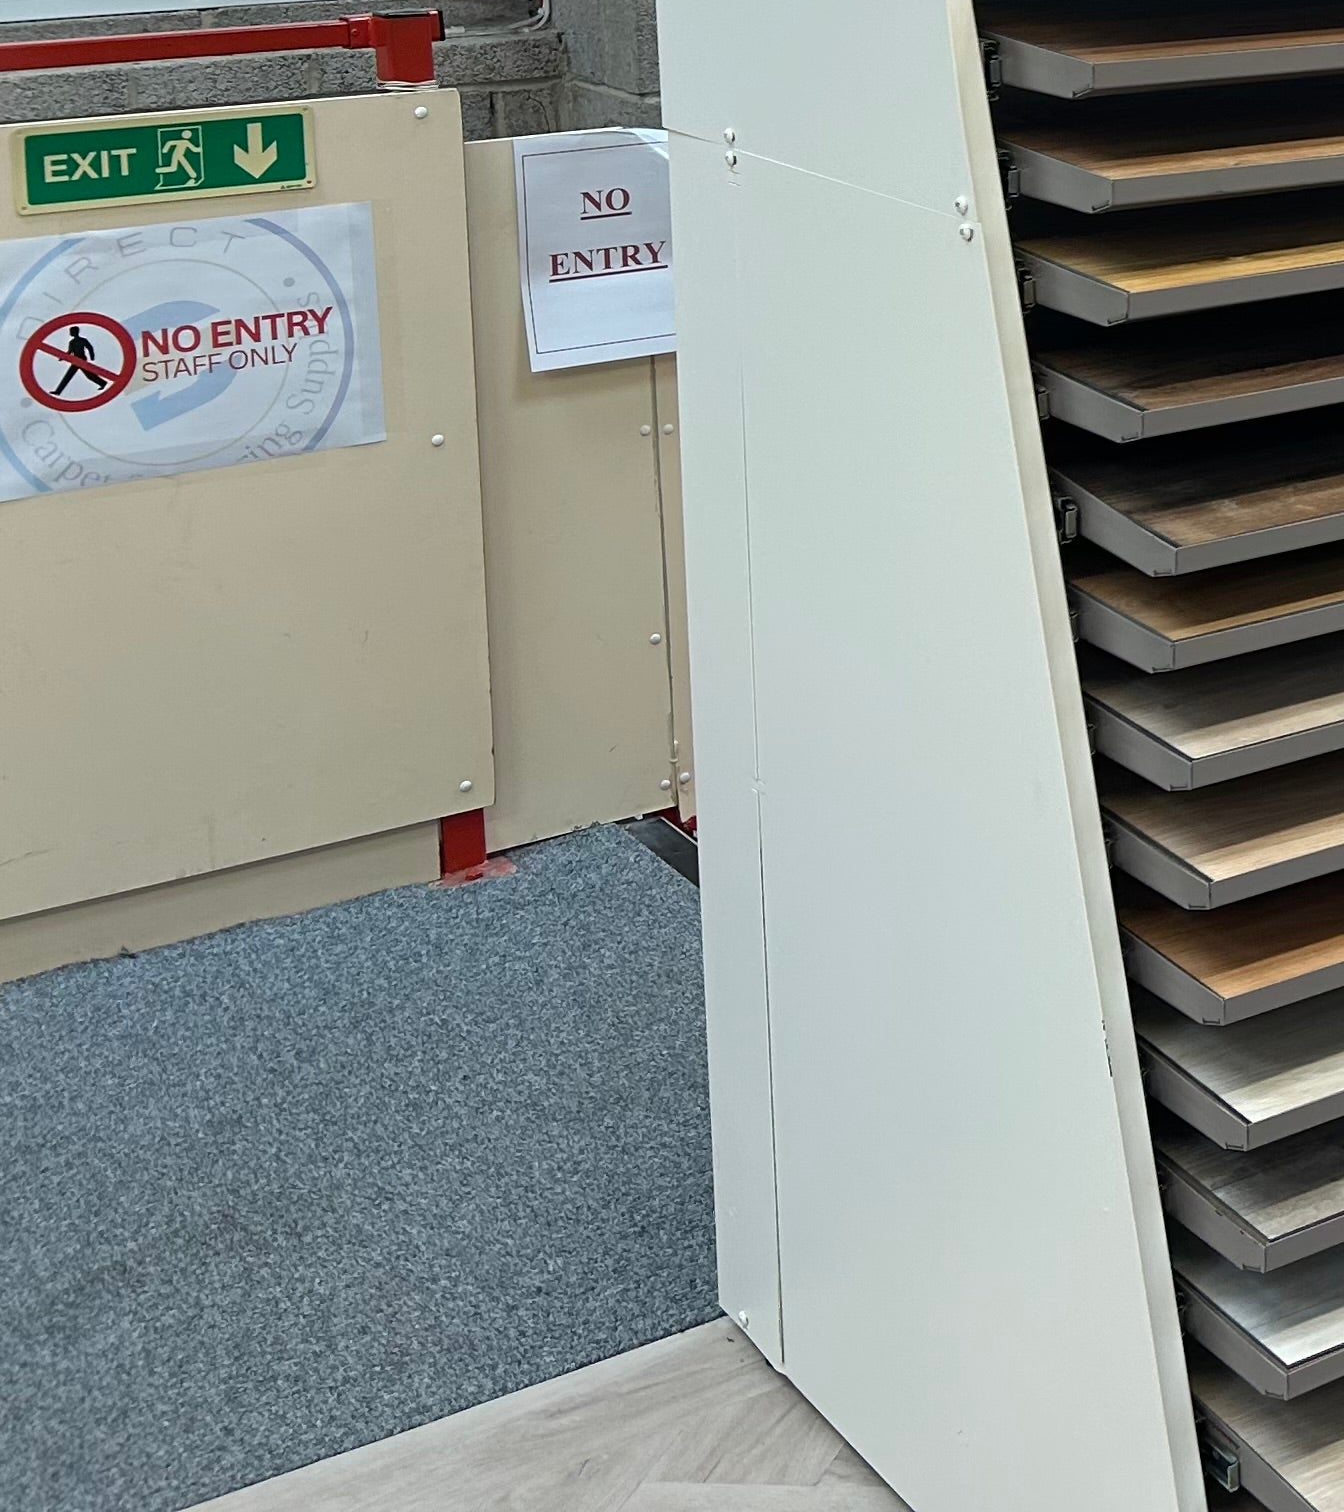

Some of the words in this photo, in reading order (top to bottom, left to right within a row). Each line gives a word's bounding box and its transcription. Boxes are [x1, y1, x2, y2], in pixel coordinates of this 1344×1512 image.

[44, 147, 137, 183] EXIT
[581, 187, 631, 214] NO
[549, 240, 667, 277] ENTRY
[17, 226, 246, 341] DIRECT
[142, 325, 201, 358] NO
[211, 307, 333, 349] ENTRY
[143, 351, 223, 383] STAFF
[228, 343, 298, 371] ONLY
